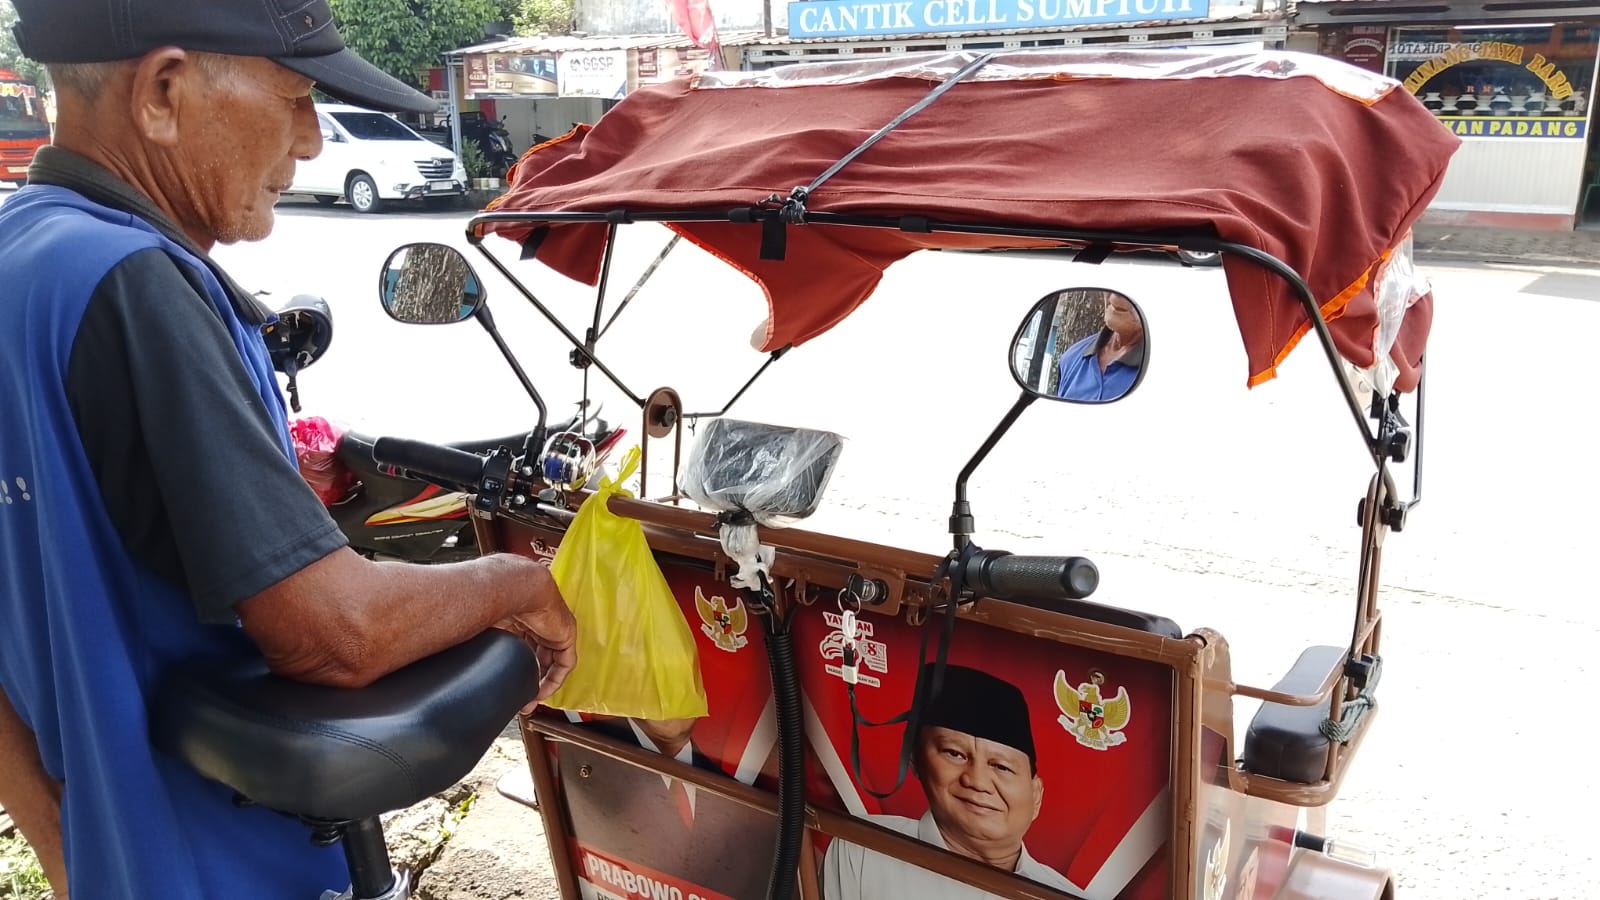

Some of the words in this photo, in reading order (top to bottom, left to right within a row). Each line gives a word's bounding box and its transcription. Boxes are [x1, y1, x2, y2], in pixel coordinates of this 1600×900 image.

[799, 2, 915, 33] CANTIK
[923, 0, 1007, 27] CELL
[1480, 41, 1524, 65] JAYA
[1526, 53, 1574, 99] BARU
[1489, 121, 1578, 136] PADANG
[585, 852, 683, 900] PRABOWO
